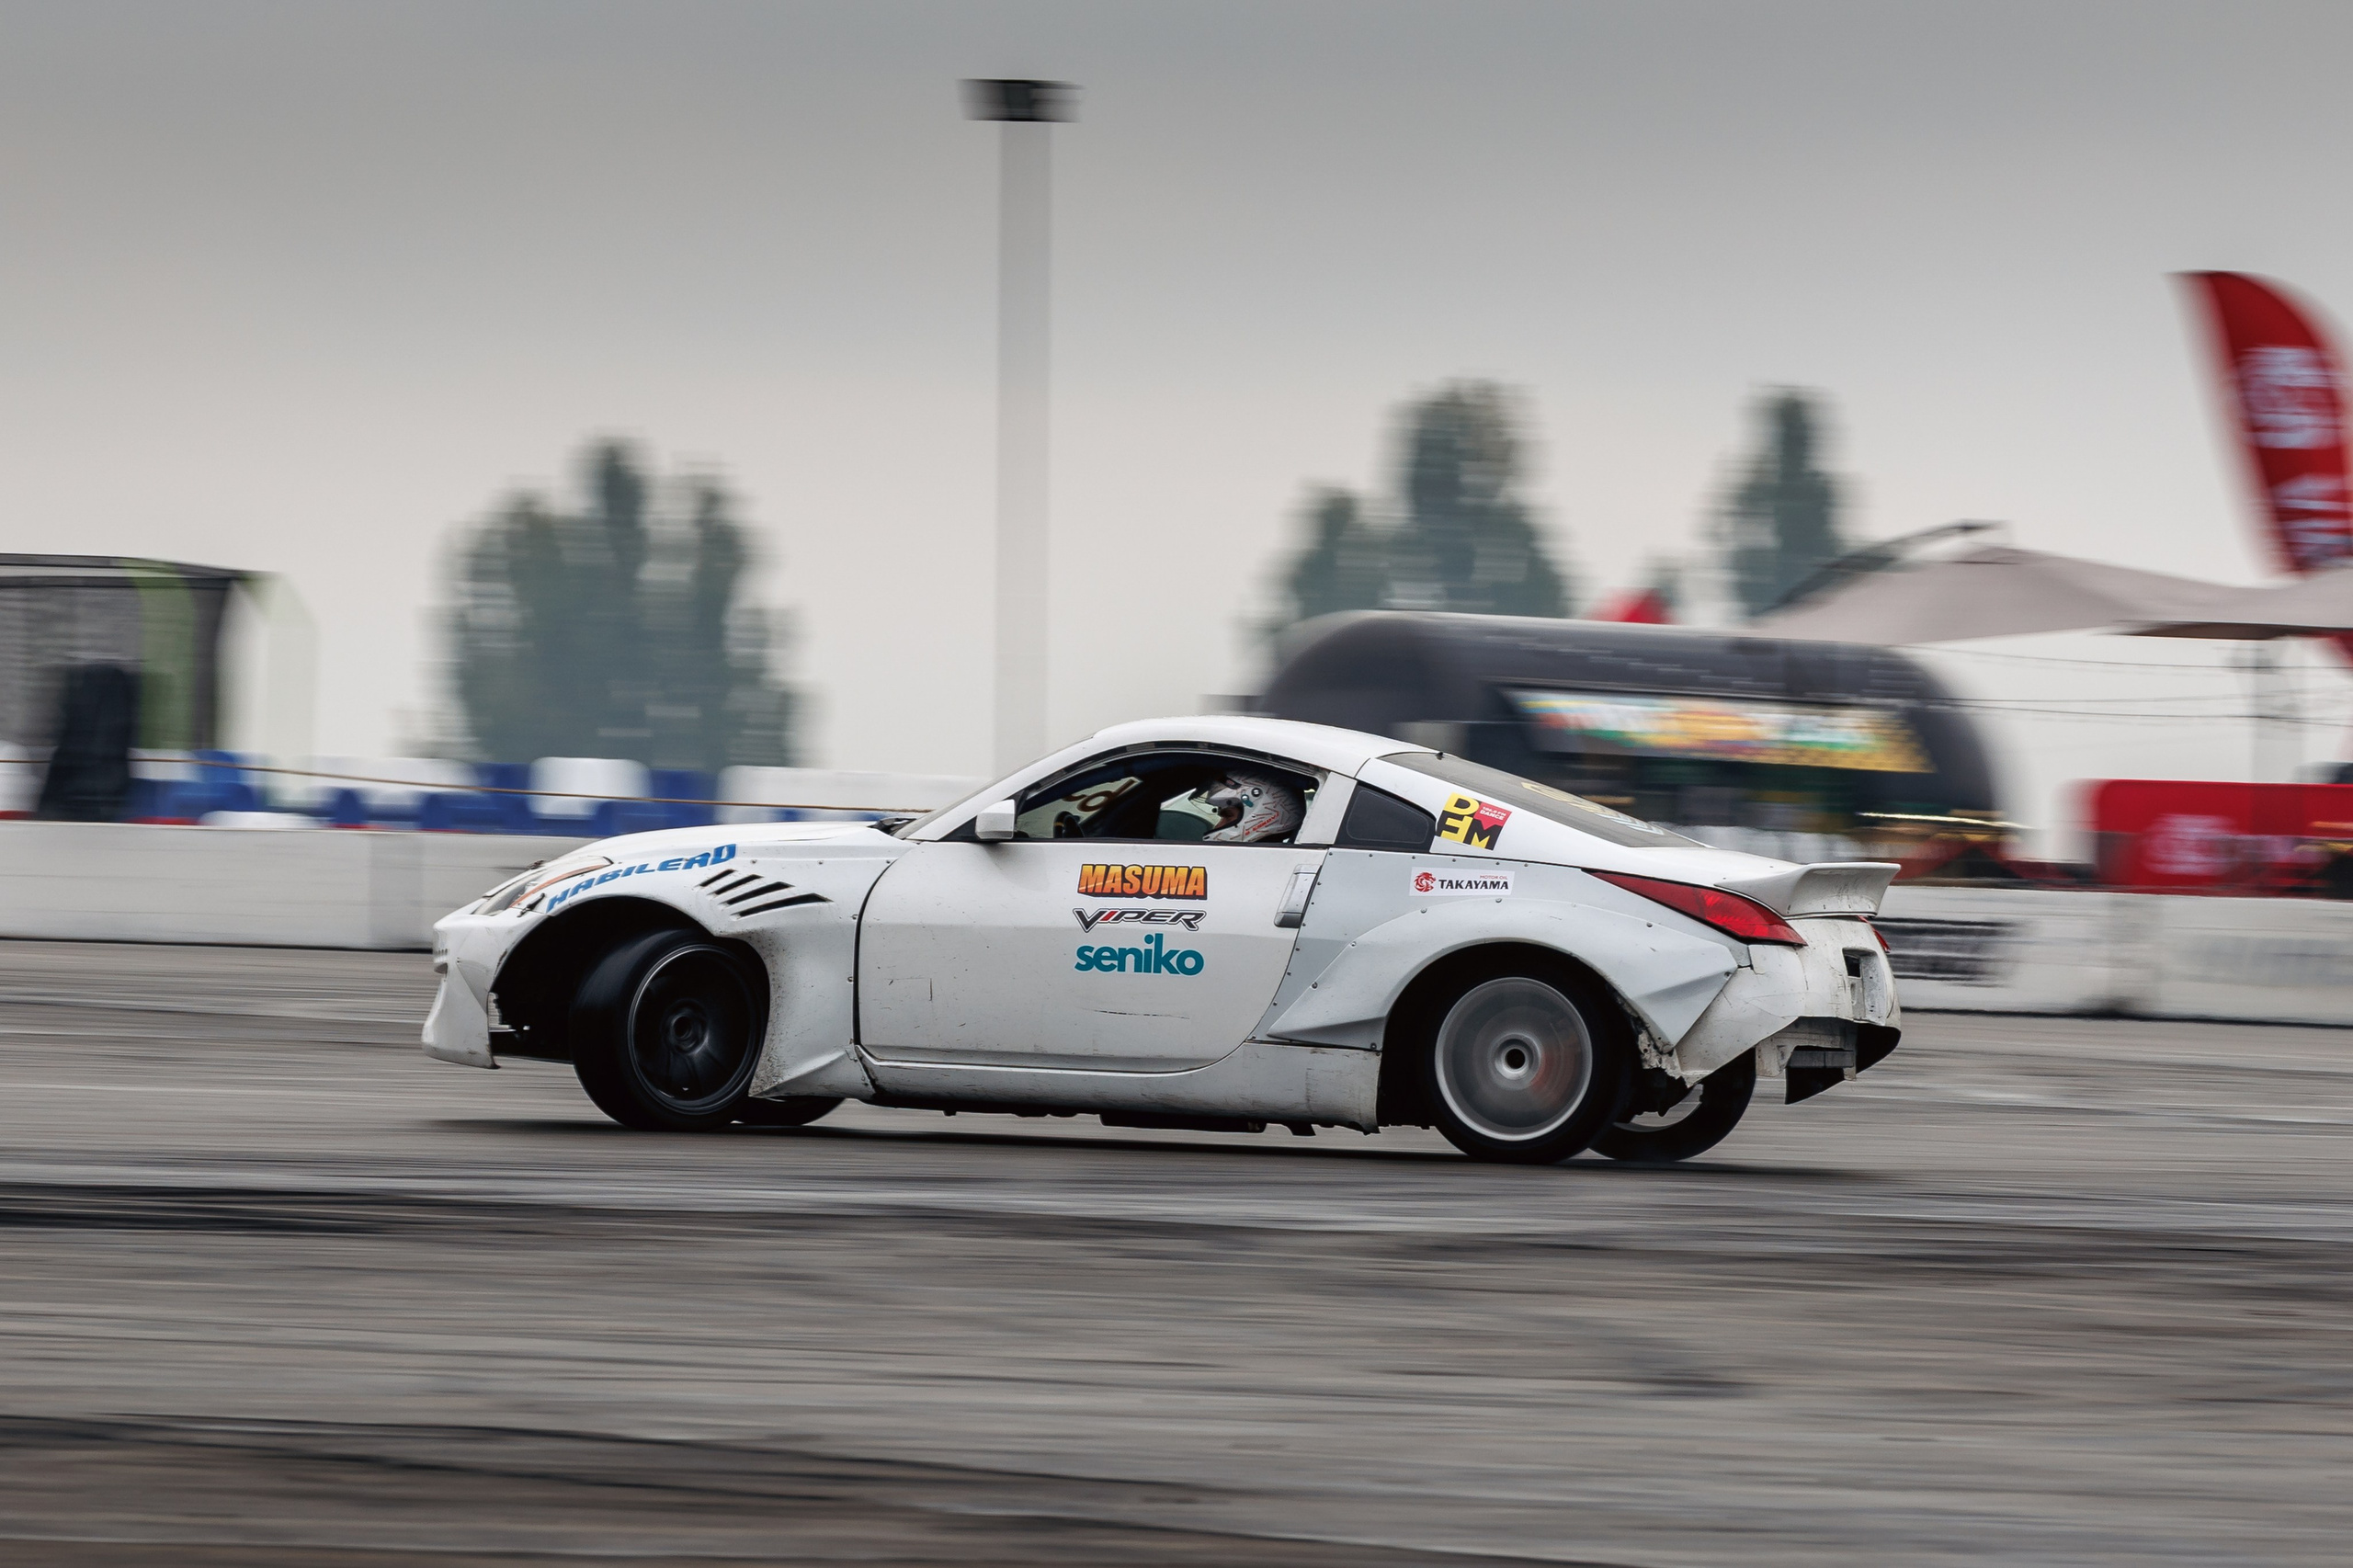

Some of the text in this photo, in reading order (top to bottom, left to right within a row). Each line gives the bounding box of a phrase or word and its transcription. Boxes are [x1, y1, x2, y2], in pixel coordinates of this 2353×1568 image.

[1479, 810, 1505, 821] DANCE
[546, 843, 737, 914] HABILEAD
[1077, 864, 1207, 900] MASUMA
[1438, 880, 1509, 890] TAKAYAMA
[1073, 908, 1207, 933] VIPER
[1074, 933, 1204, 976] seniko
